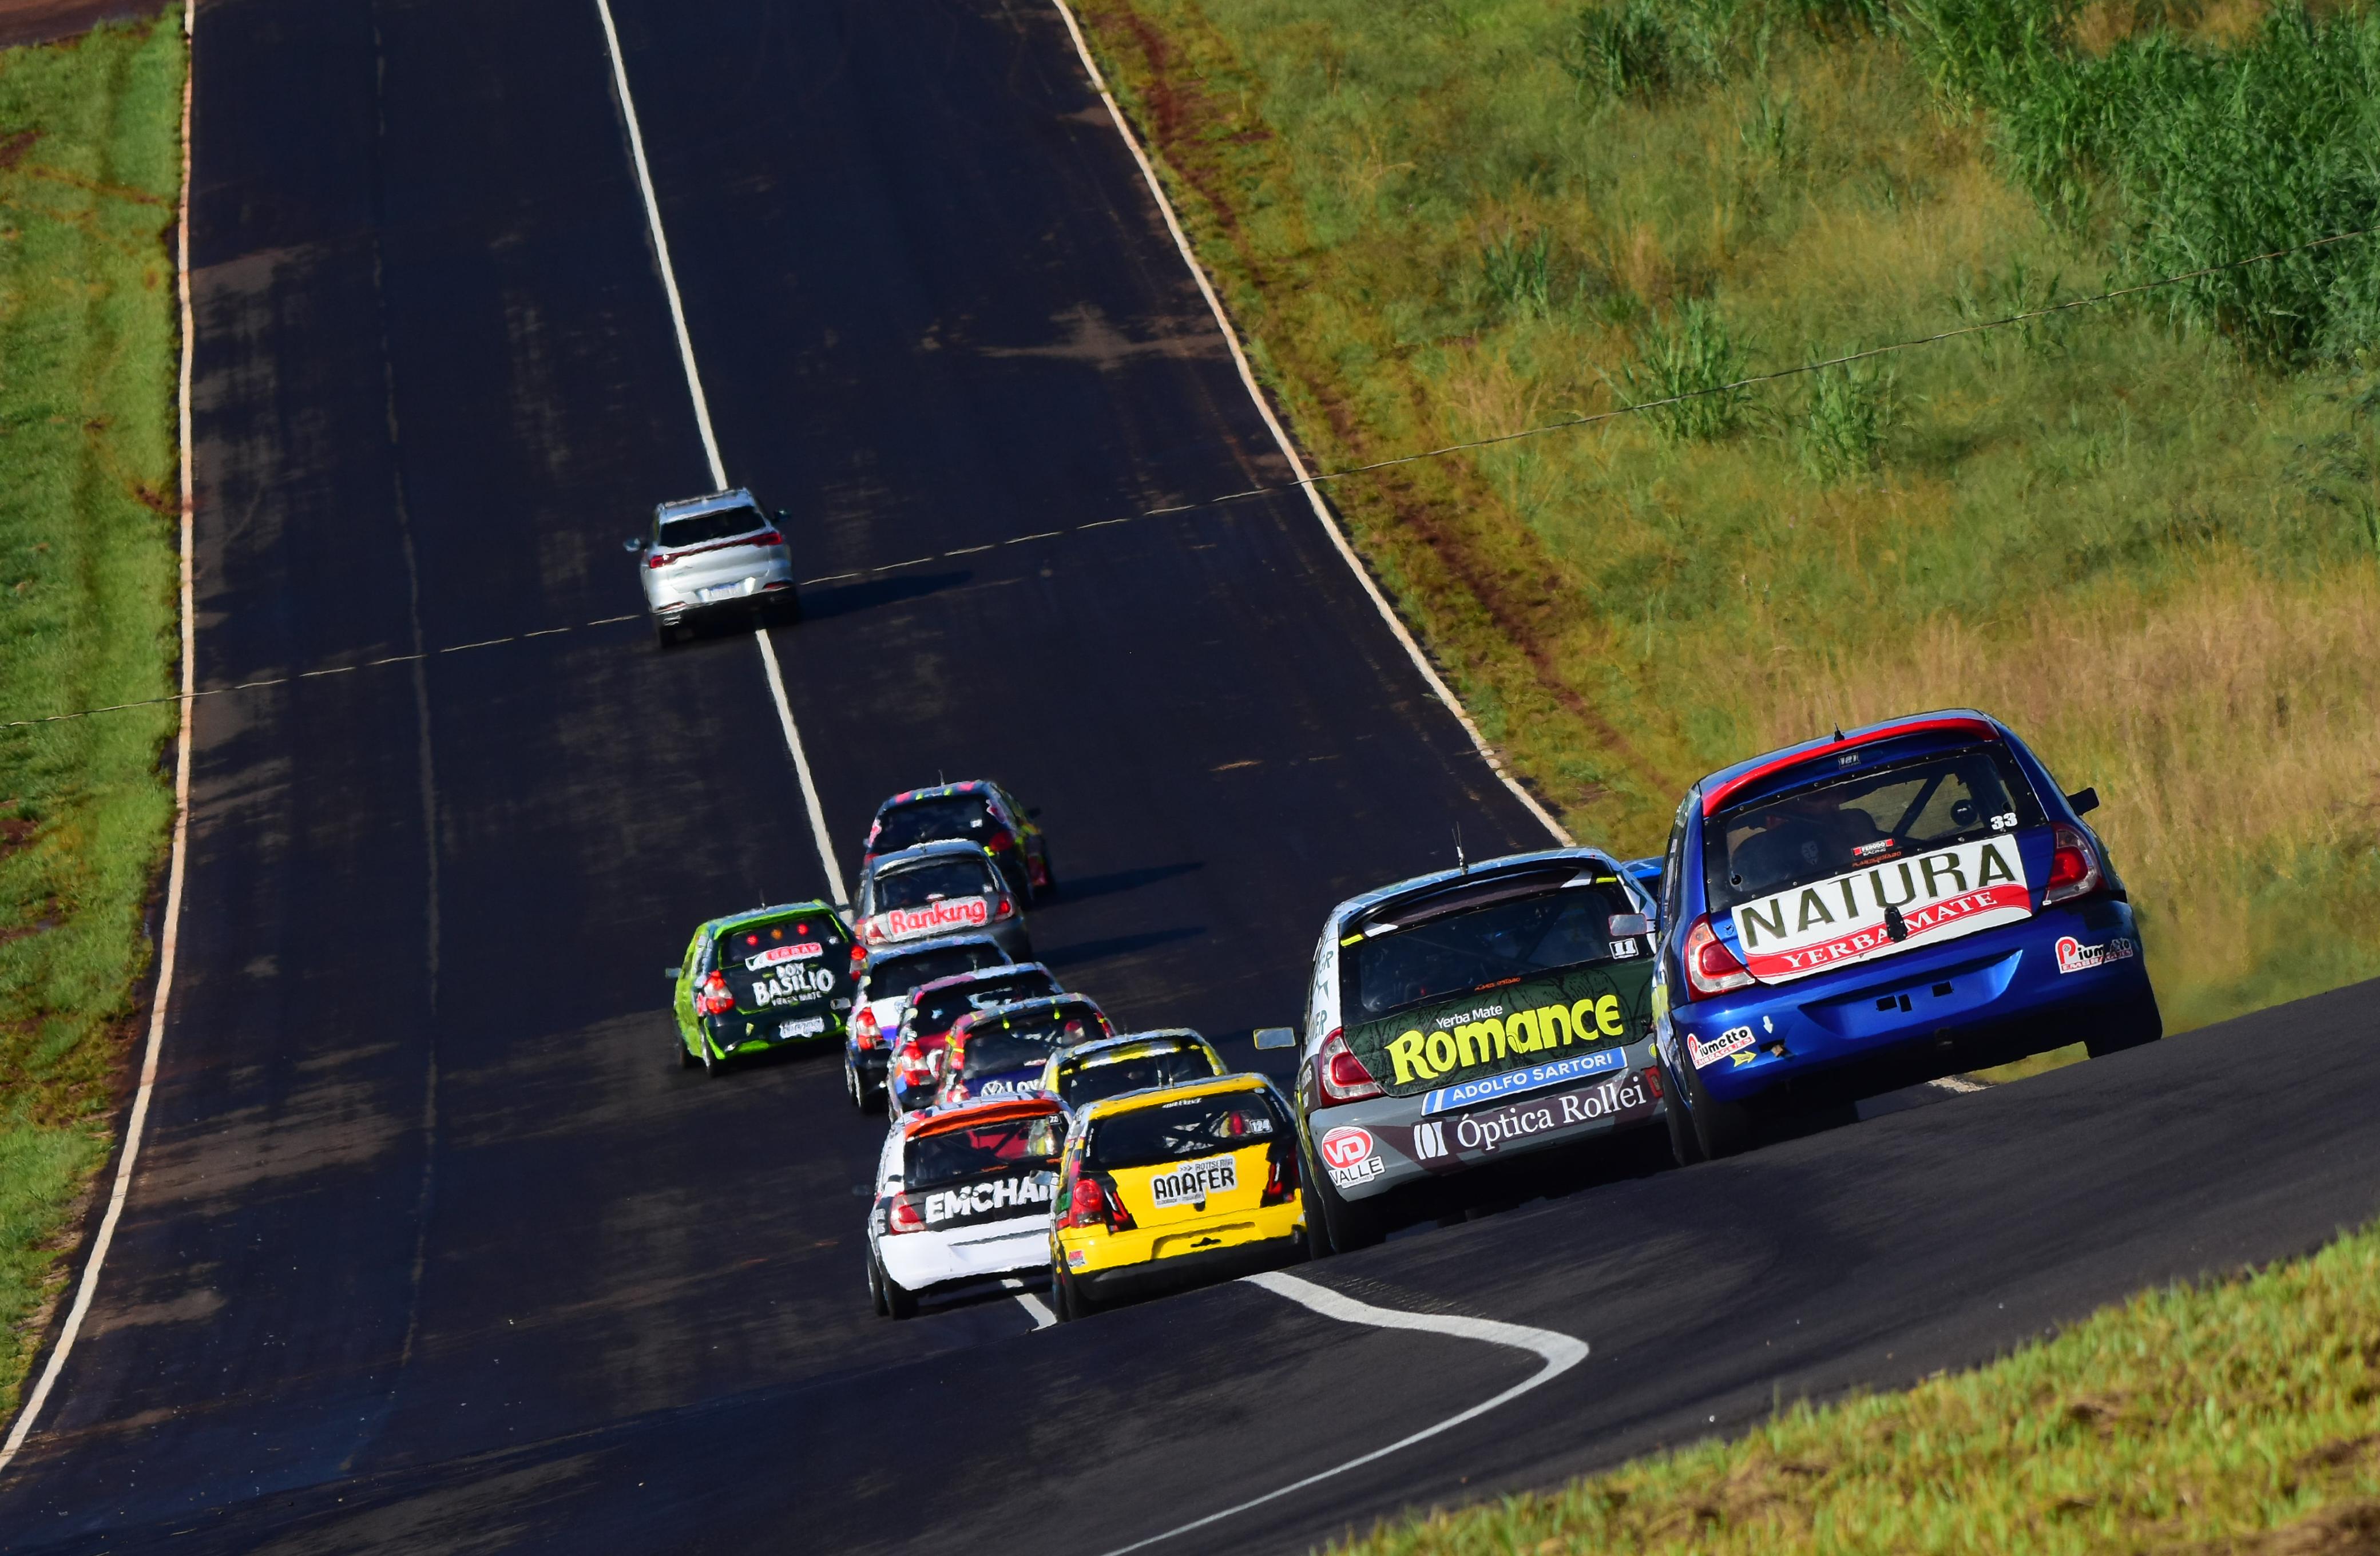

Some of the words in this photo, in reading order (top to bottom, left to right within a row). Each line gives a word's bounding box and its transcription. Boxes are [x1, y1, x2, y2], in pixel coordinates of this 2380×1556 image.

[1990, 812, 2018, 829] 33
[1740, 844, 2016, 948] NATURA
[889, 900, 986, 934] Ranking
[1780, 928, 1887, 968] YERBA
[1906, 891, 1998, 932] MATE
[1614, 940, 1636, 956] 11
[776, 962, 806, 979] DON
[752, 968, 835, 1007] BASILIO
[1435, 1011, 1470, 1029] Yerba
[1472, 1005, 1503, 1019] Mate
[1383, 994, 1624, 1086] Romance
[1688, 1029, 1748, 1061] Piumetto
[1453, 1073, 1528, 1102] ADOLFO
[1532, 1053, 1613, 1081] SARTORI
[1457, 1108, 1554, 1150] Óptica
[1559, 1076, 1647, 1123] Rollei
[1324, 1136, 1366, 1164] VD
[1330, 1158, 1383, 1184] VALLE
